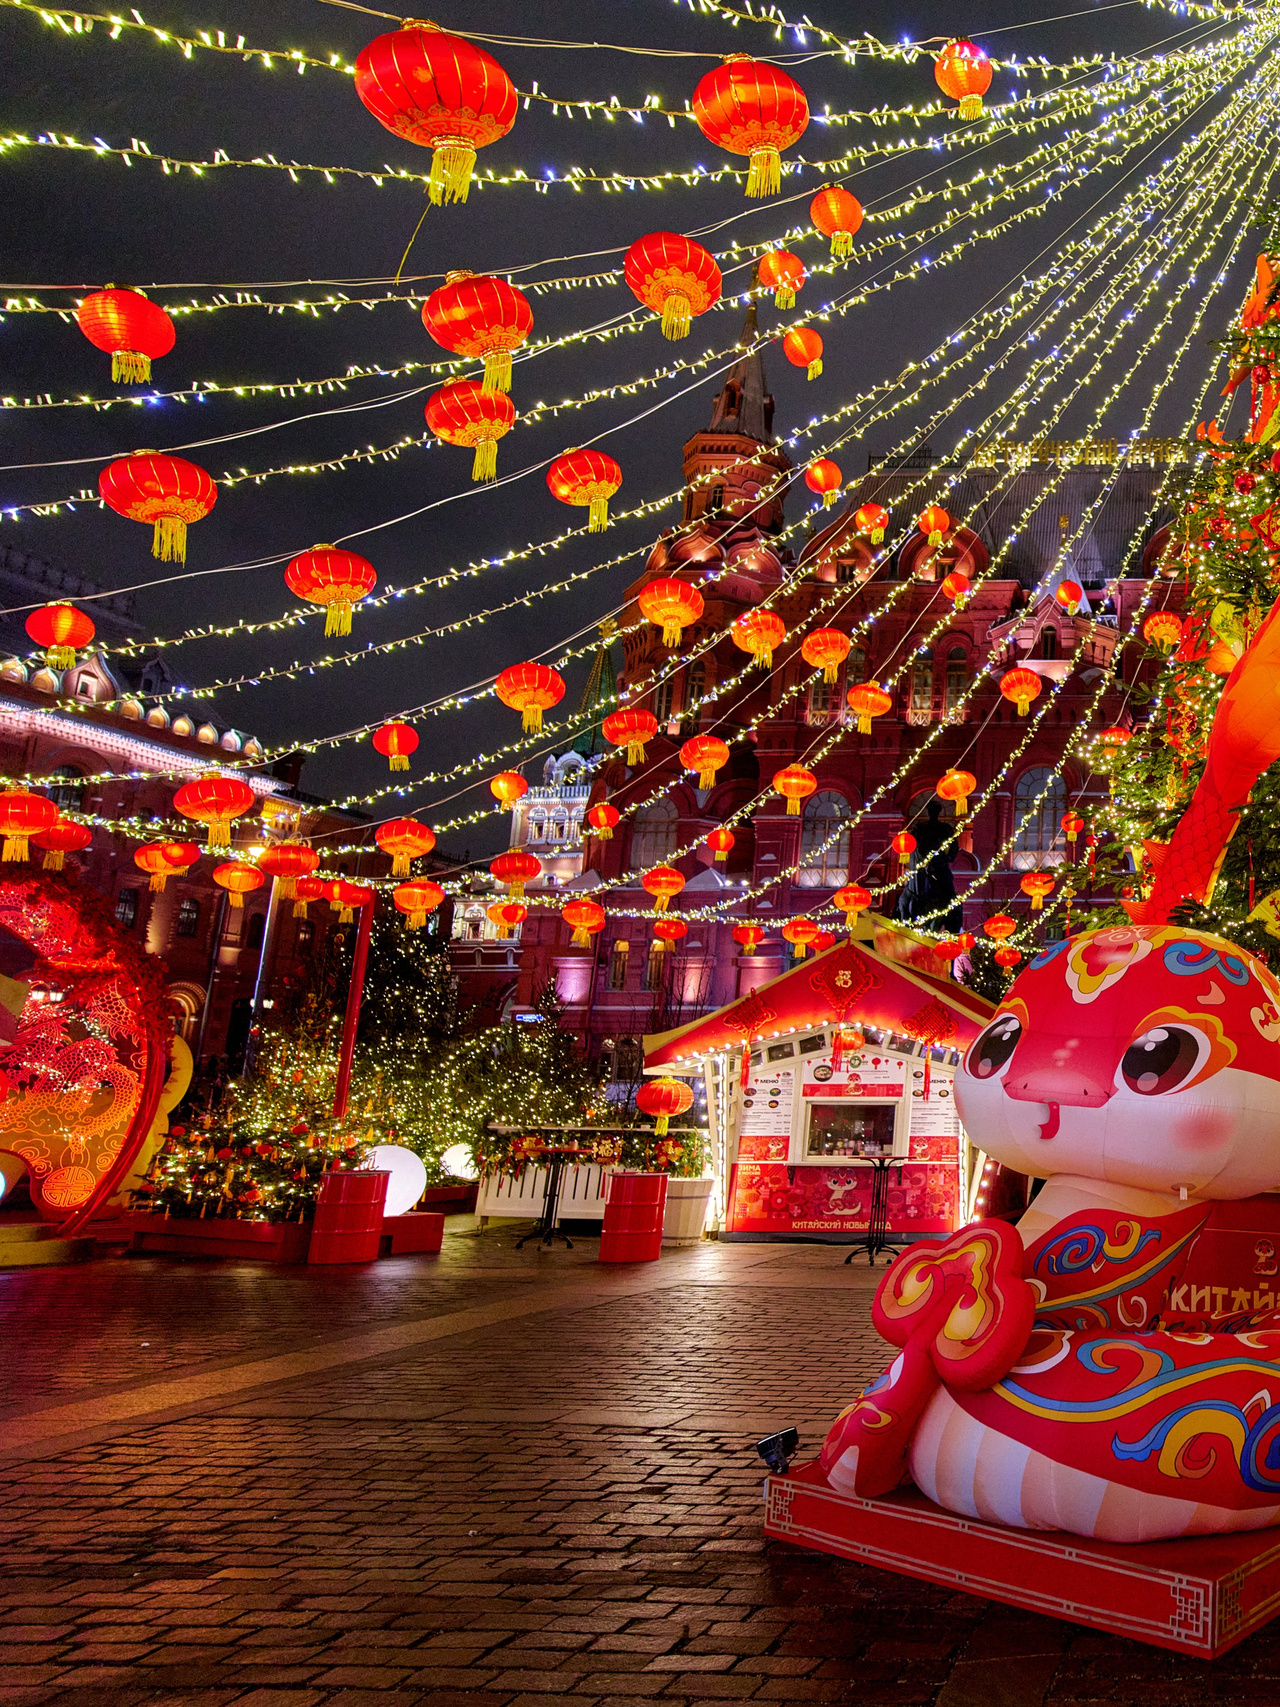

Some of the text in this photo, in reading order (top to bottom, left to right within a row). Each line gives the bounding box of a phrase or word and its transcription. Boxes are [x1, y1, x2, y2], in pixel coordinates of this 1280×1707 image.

[738, 1164, 761, 1172] ЗИМА
[792, 1220, 841, 1230] КИТАЙСКИЙ
[843, 1220, 870, 1230] НОВЫЙ
